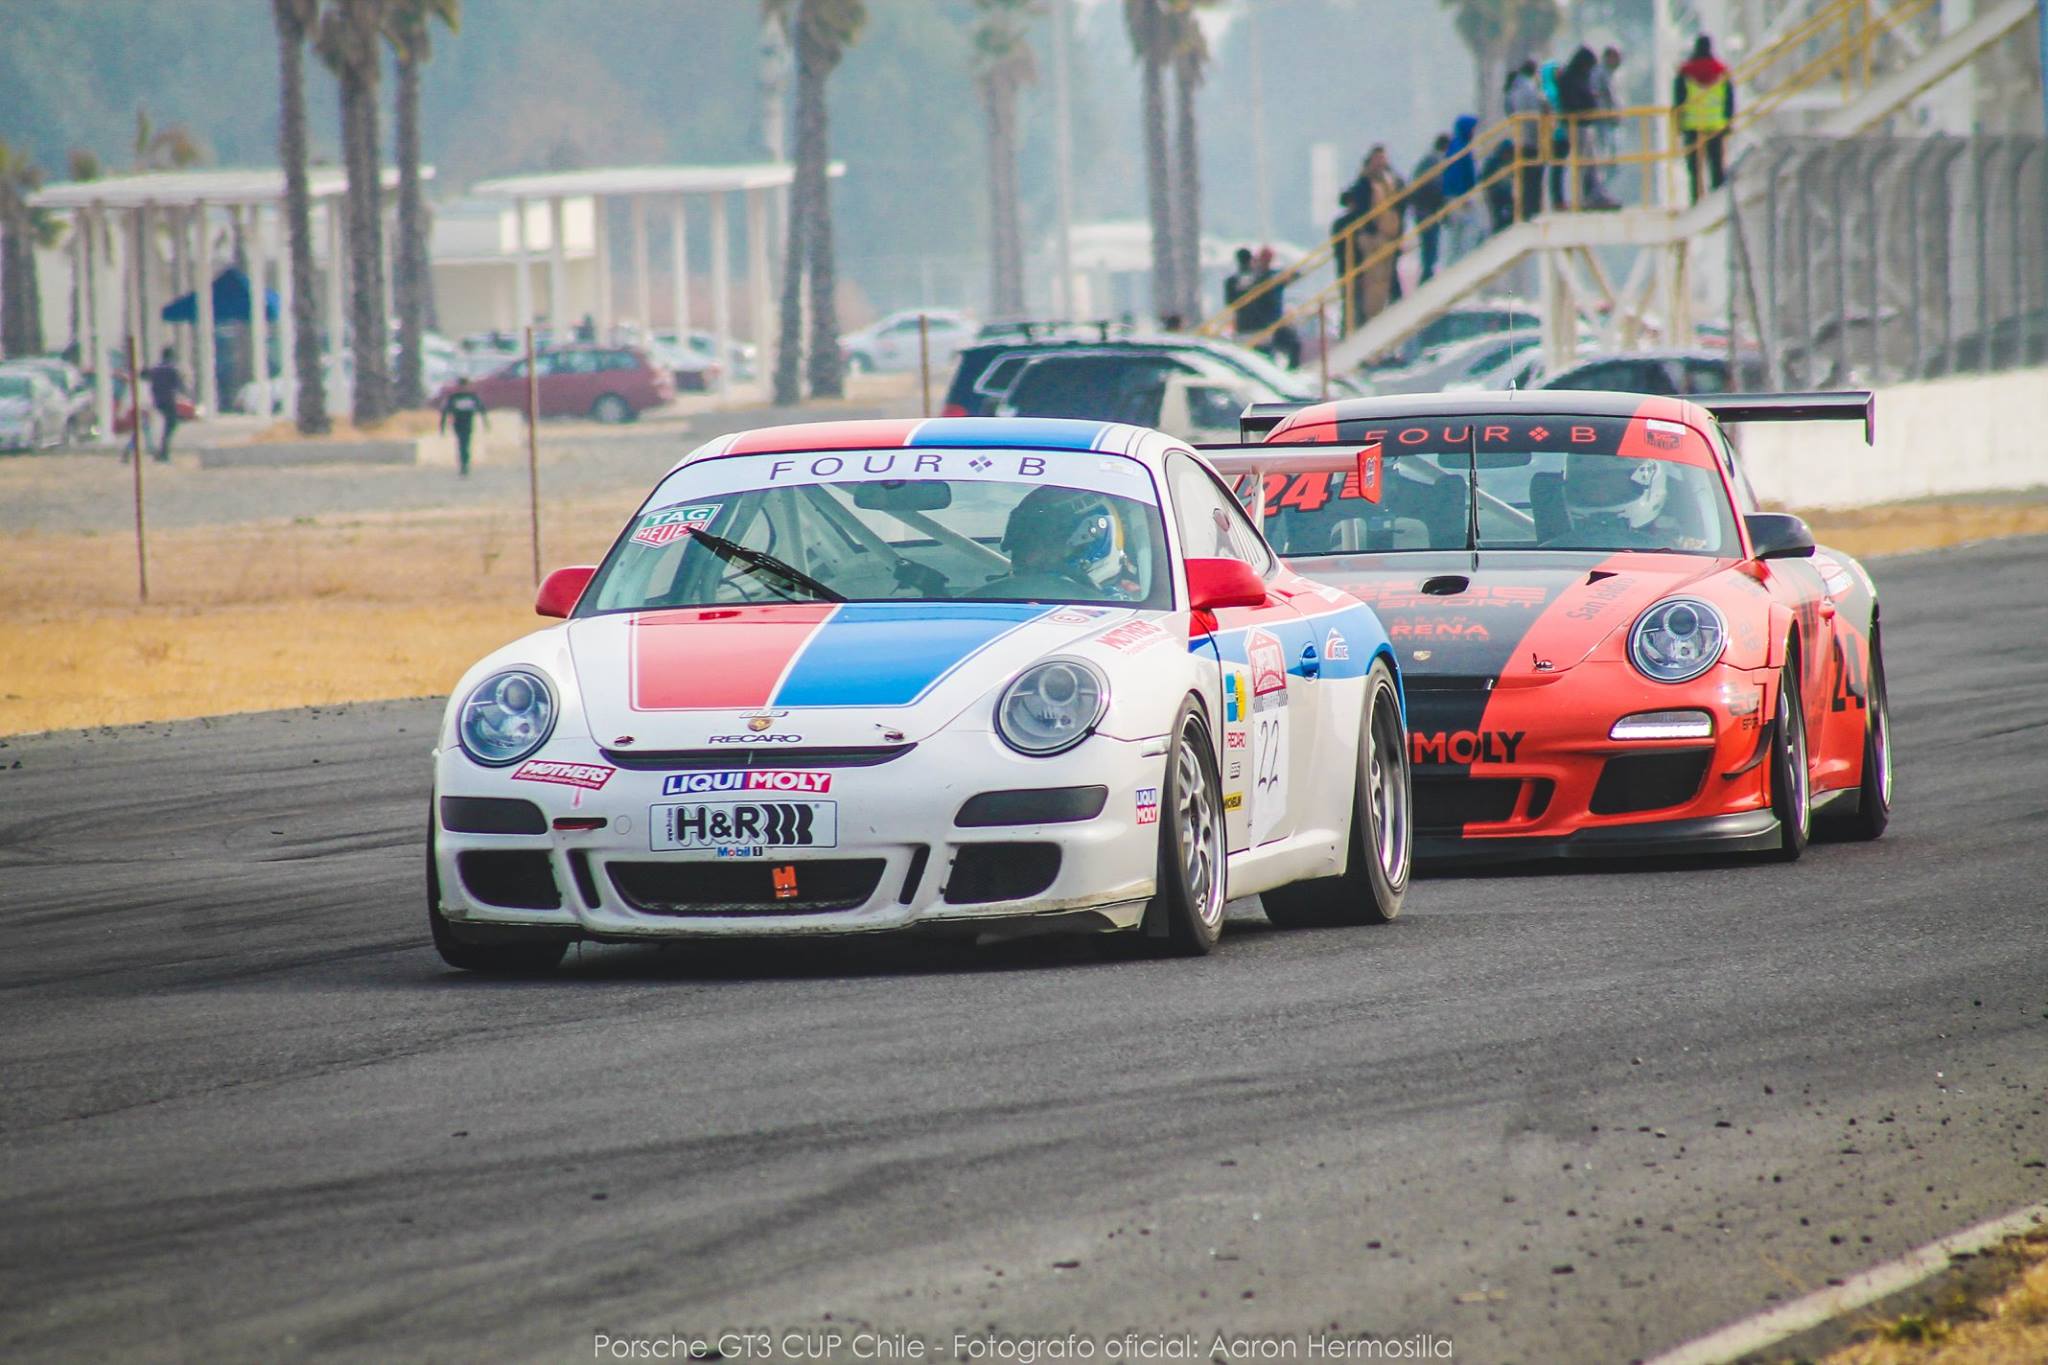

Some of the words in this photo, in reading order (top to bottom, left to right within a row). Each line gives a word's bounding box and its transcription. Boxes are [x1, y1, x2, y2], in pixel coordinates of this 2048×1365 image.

[1364, 426, 1510, 445] FOUR
[1572, 426, 1597, 443] B
[769, 454, 943, 481] FOUR
[1018, 456, 1047, 476] B
[1244, 471, 1329, 516] 24
[650, 508, 710, 525] TAG
[1390, 624, 1489, 636] RENA
[1832, 632, 1866, 712] 24
[708, 735, 802, 744] RECARO
[1413, 730, 1527, 764] MOLY
[1257, 720, 1279, 793] 22
[520, 761, 613, 782] MOTHERS
[665, 773, 744, 793] LIQUI
[749, 772, 831, 791] MOLY
[1137, 790, 1156, 806] LIQUI
[677, 806, 760, 840] H&R
[1137, 807, 1156, 823] MOLY
[717, 846, 750, 857] Mobil
[753, 847, 762, 857] 1
